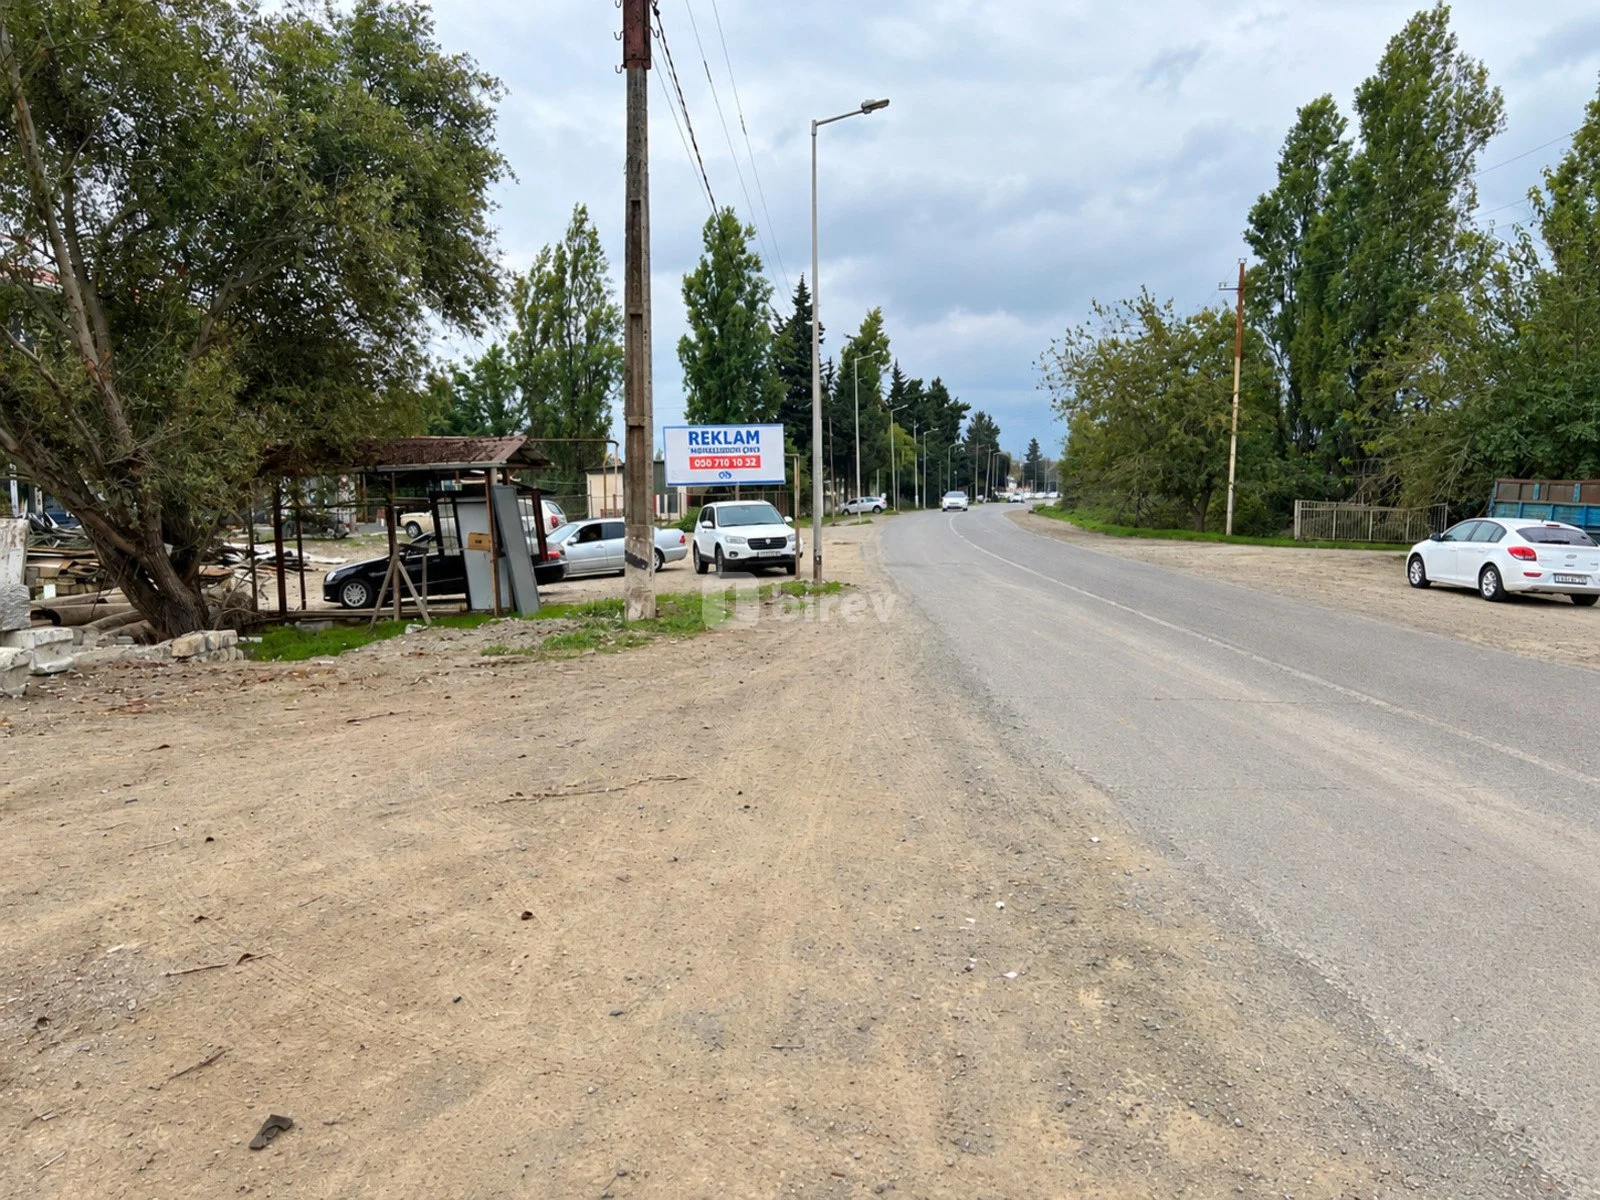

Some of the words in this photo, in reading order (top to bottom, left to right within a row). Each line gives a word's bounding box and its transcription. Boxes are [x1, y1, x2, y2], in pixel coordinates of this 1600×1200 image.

[688, 430, 760, 445] REKLAM
[714, 458, 730, 467] 710
[732, 458, 743, 467] 10
